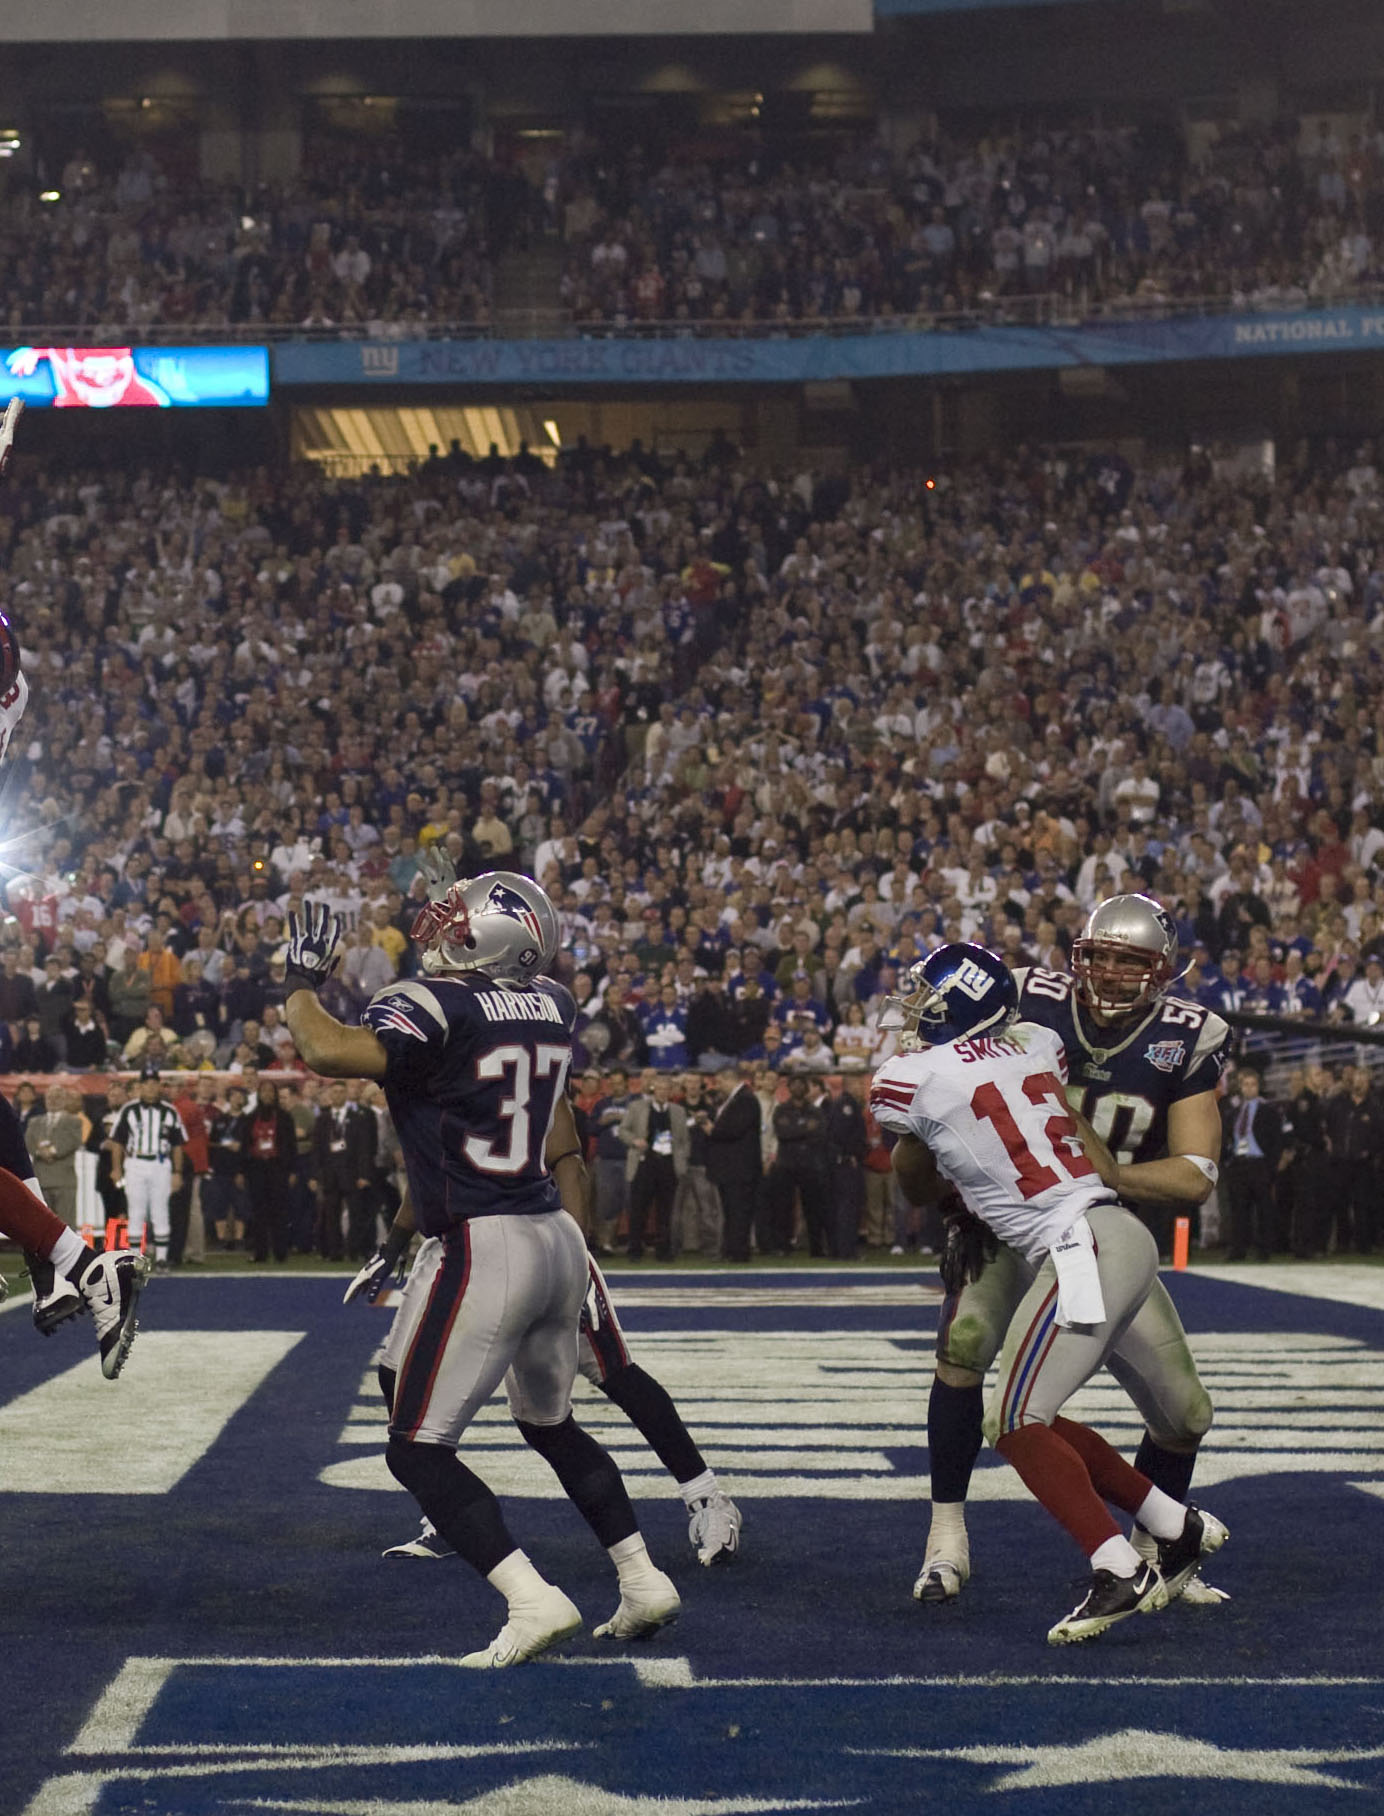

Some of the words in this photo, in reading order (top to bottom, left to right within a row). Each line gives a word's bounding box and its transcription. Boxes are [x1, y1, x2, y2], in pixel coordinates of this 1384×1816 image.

[1234, 319, 1354, 344] NATIONAL
[473, 991, 564, 1025] HARRISON
[953, 1035, 1028, 1064] SMITH
[464, 1043, 573, 1176] 37
[969, 1071, 1097, 1202] 12
